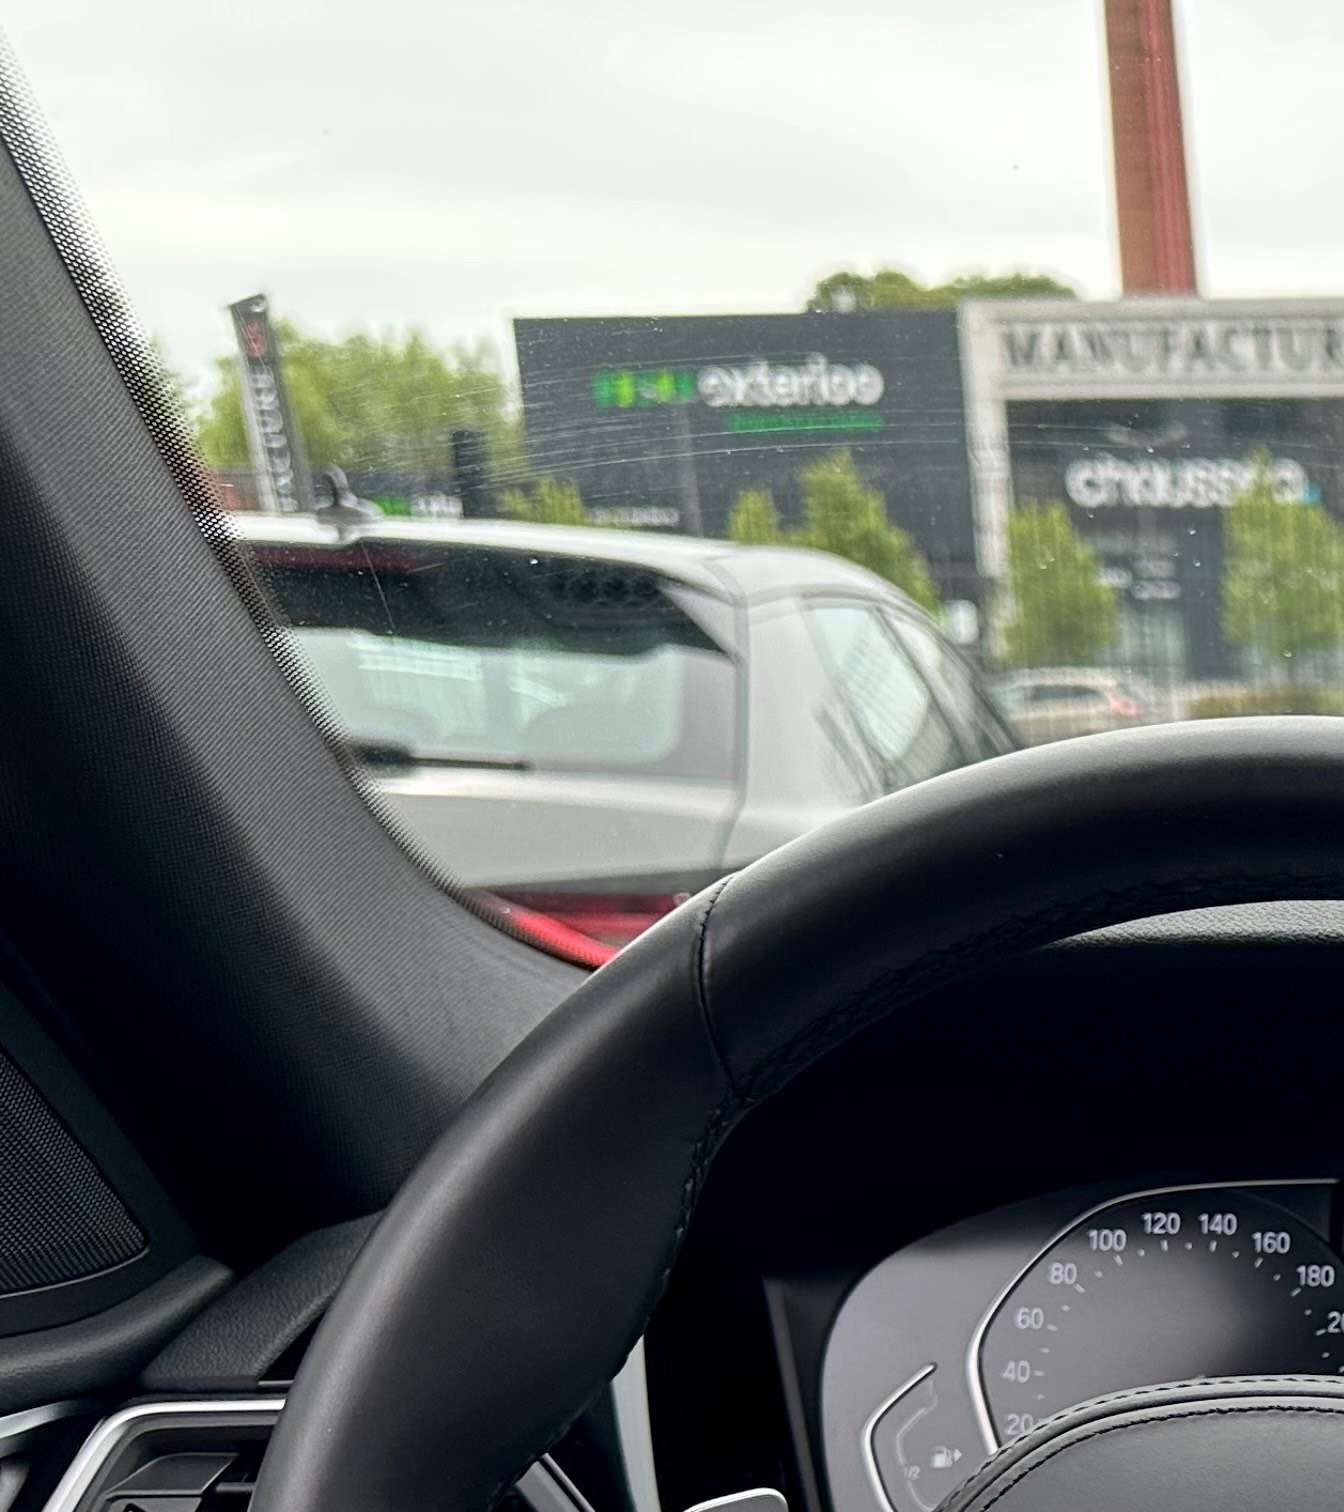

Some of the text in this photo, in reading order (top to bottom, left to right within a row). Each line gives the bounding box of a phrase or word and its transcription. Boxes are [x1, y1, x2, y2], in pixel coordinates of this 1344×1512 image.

[1143, 1212, 1181, 1235] 120
[1200, 1213, 1238, 1236] 140
[1089, 1229, 1126, 1252] 100
[1253, 1232, 1290, 1254] 160
[1049, 1263, 1077, 1285] 80
[1298, 1265, 1335, 1288] 180
[1016, 1308, 1043, 1330] 60
[1003, 1361, 1030, 1383] 40
[1006, 1414, 1034, 1436] 20
